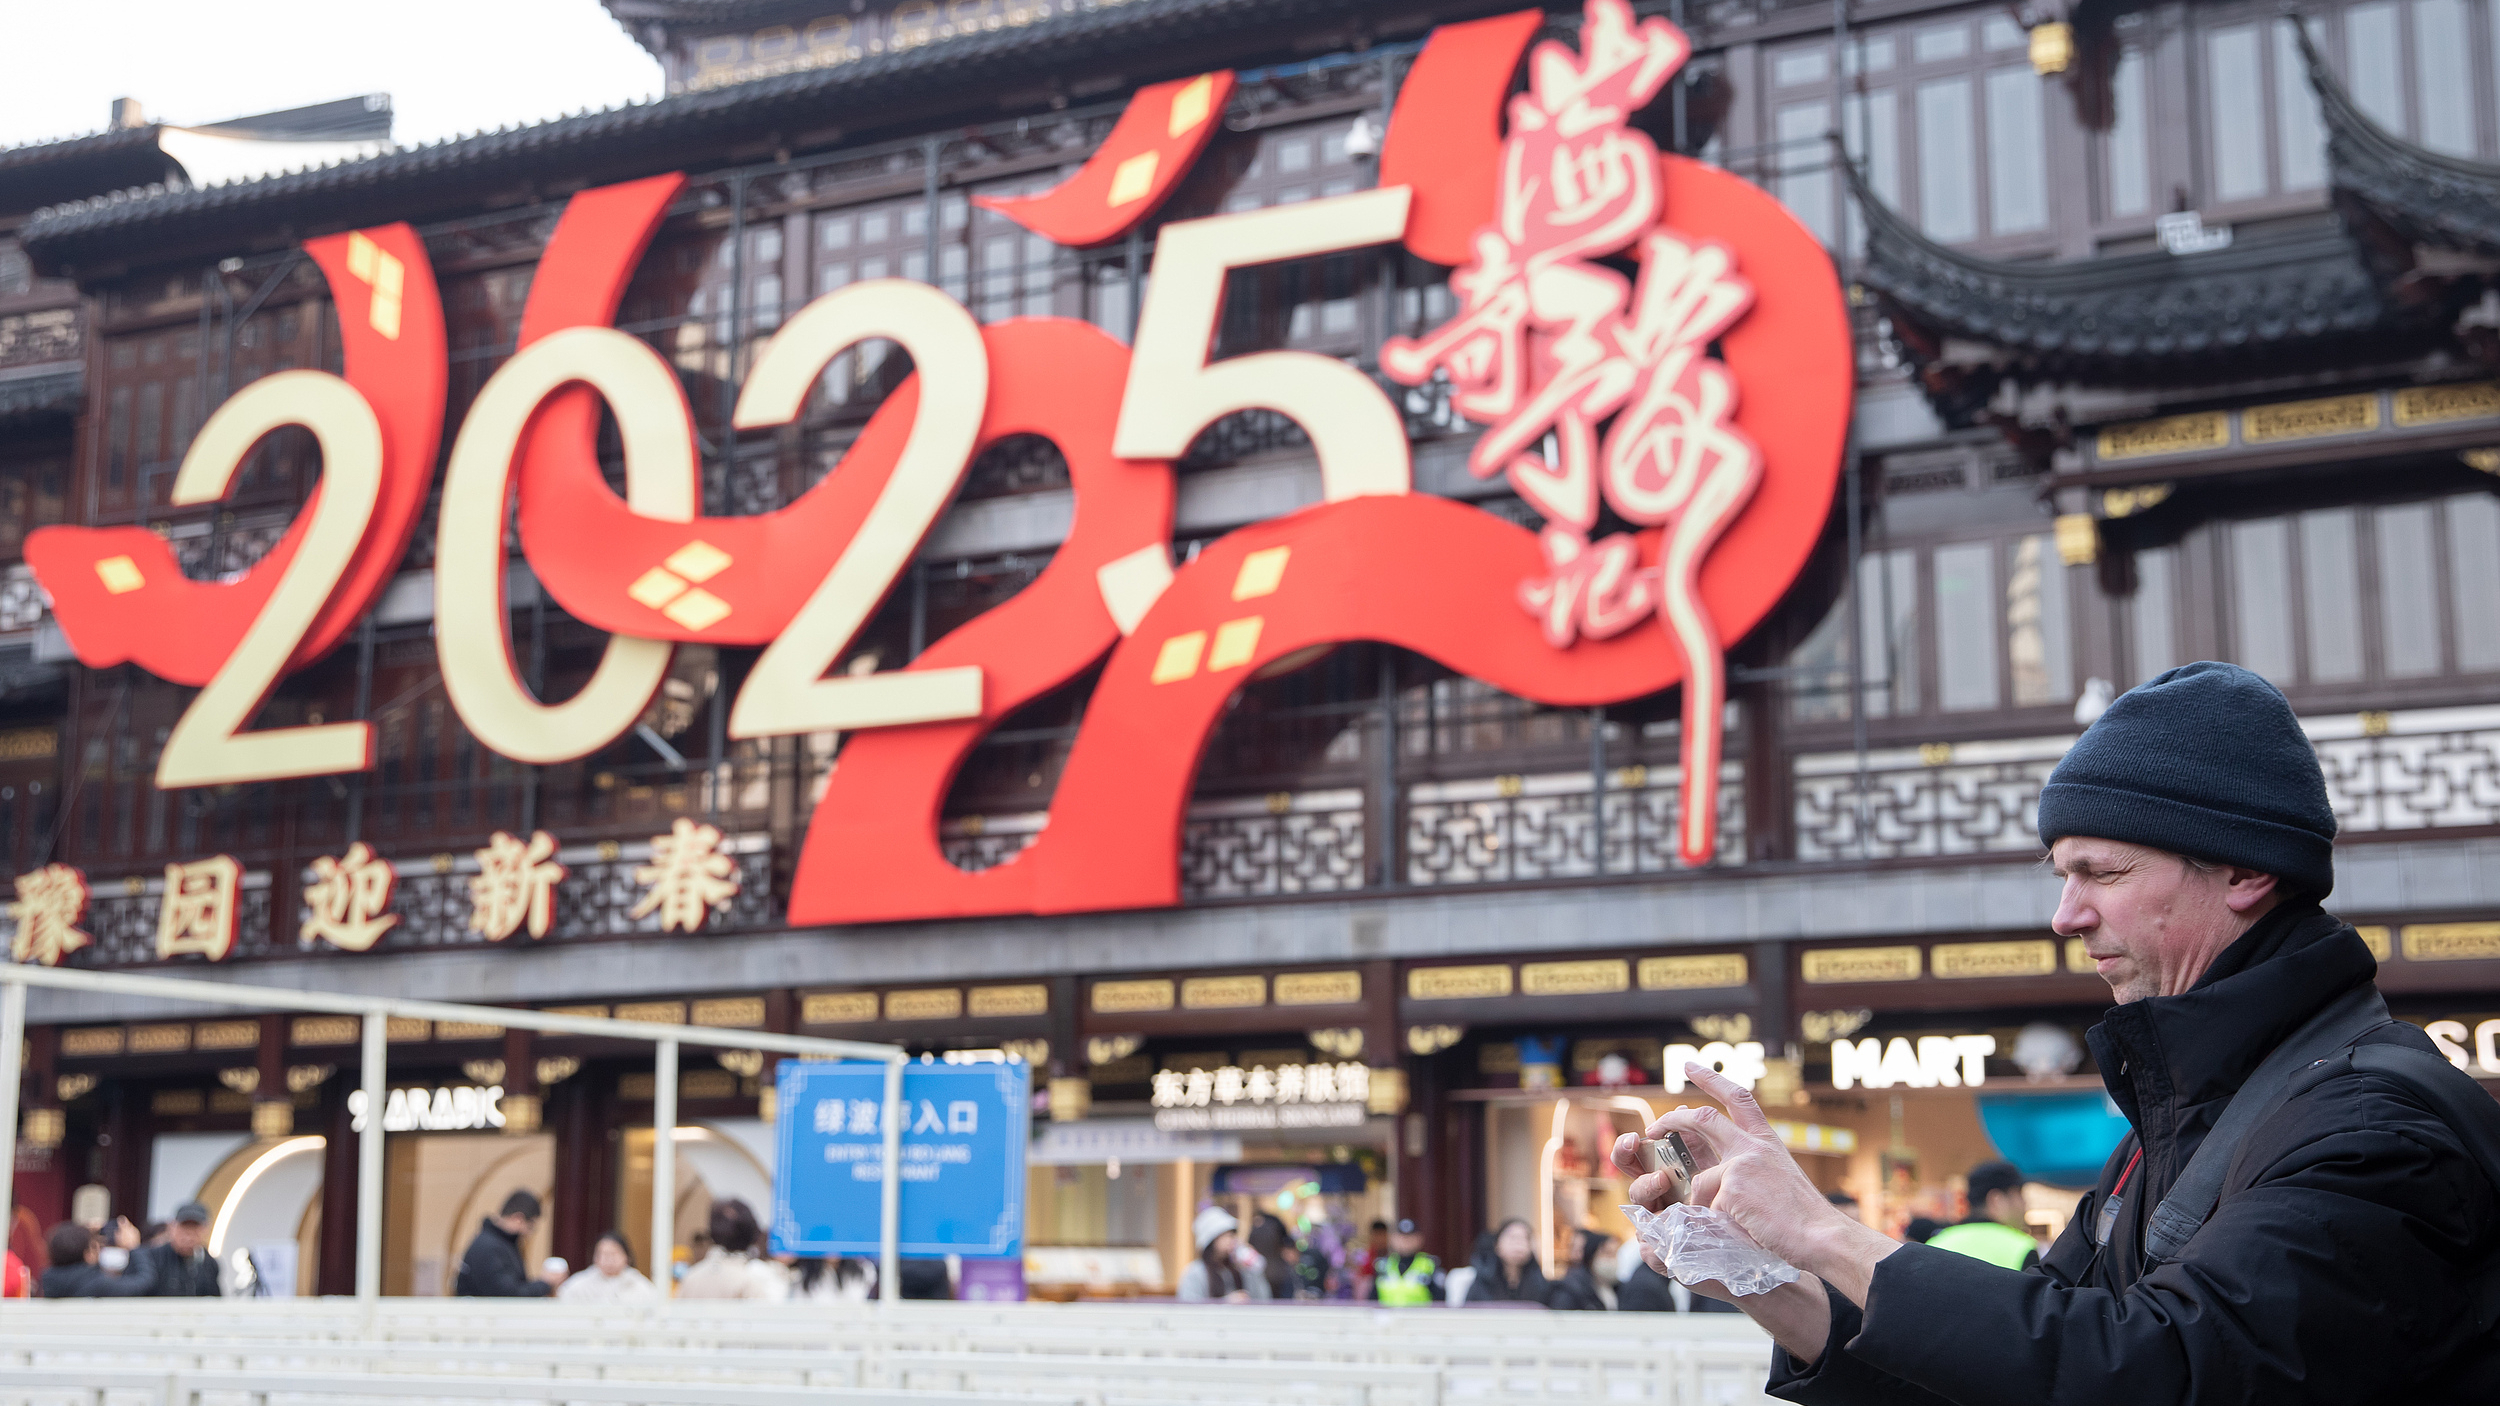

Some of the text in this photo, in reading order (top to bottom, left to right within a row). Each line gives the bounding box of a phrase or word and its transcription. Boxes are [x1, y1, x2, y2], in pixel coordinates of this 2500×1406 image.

[156, 185, 1411, 788] 2025
[11, 817, 740, 966] 豫园迎新春
[383, 1086, 506, 1131] ARABIC
[1831, 1035, 1996, 1090] MART
